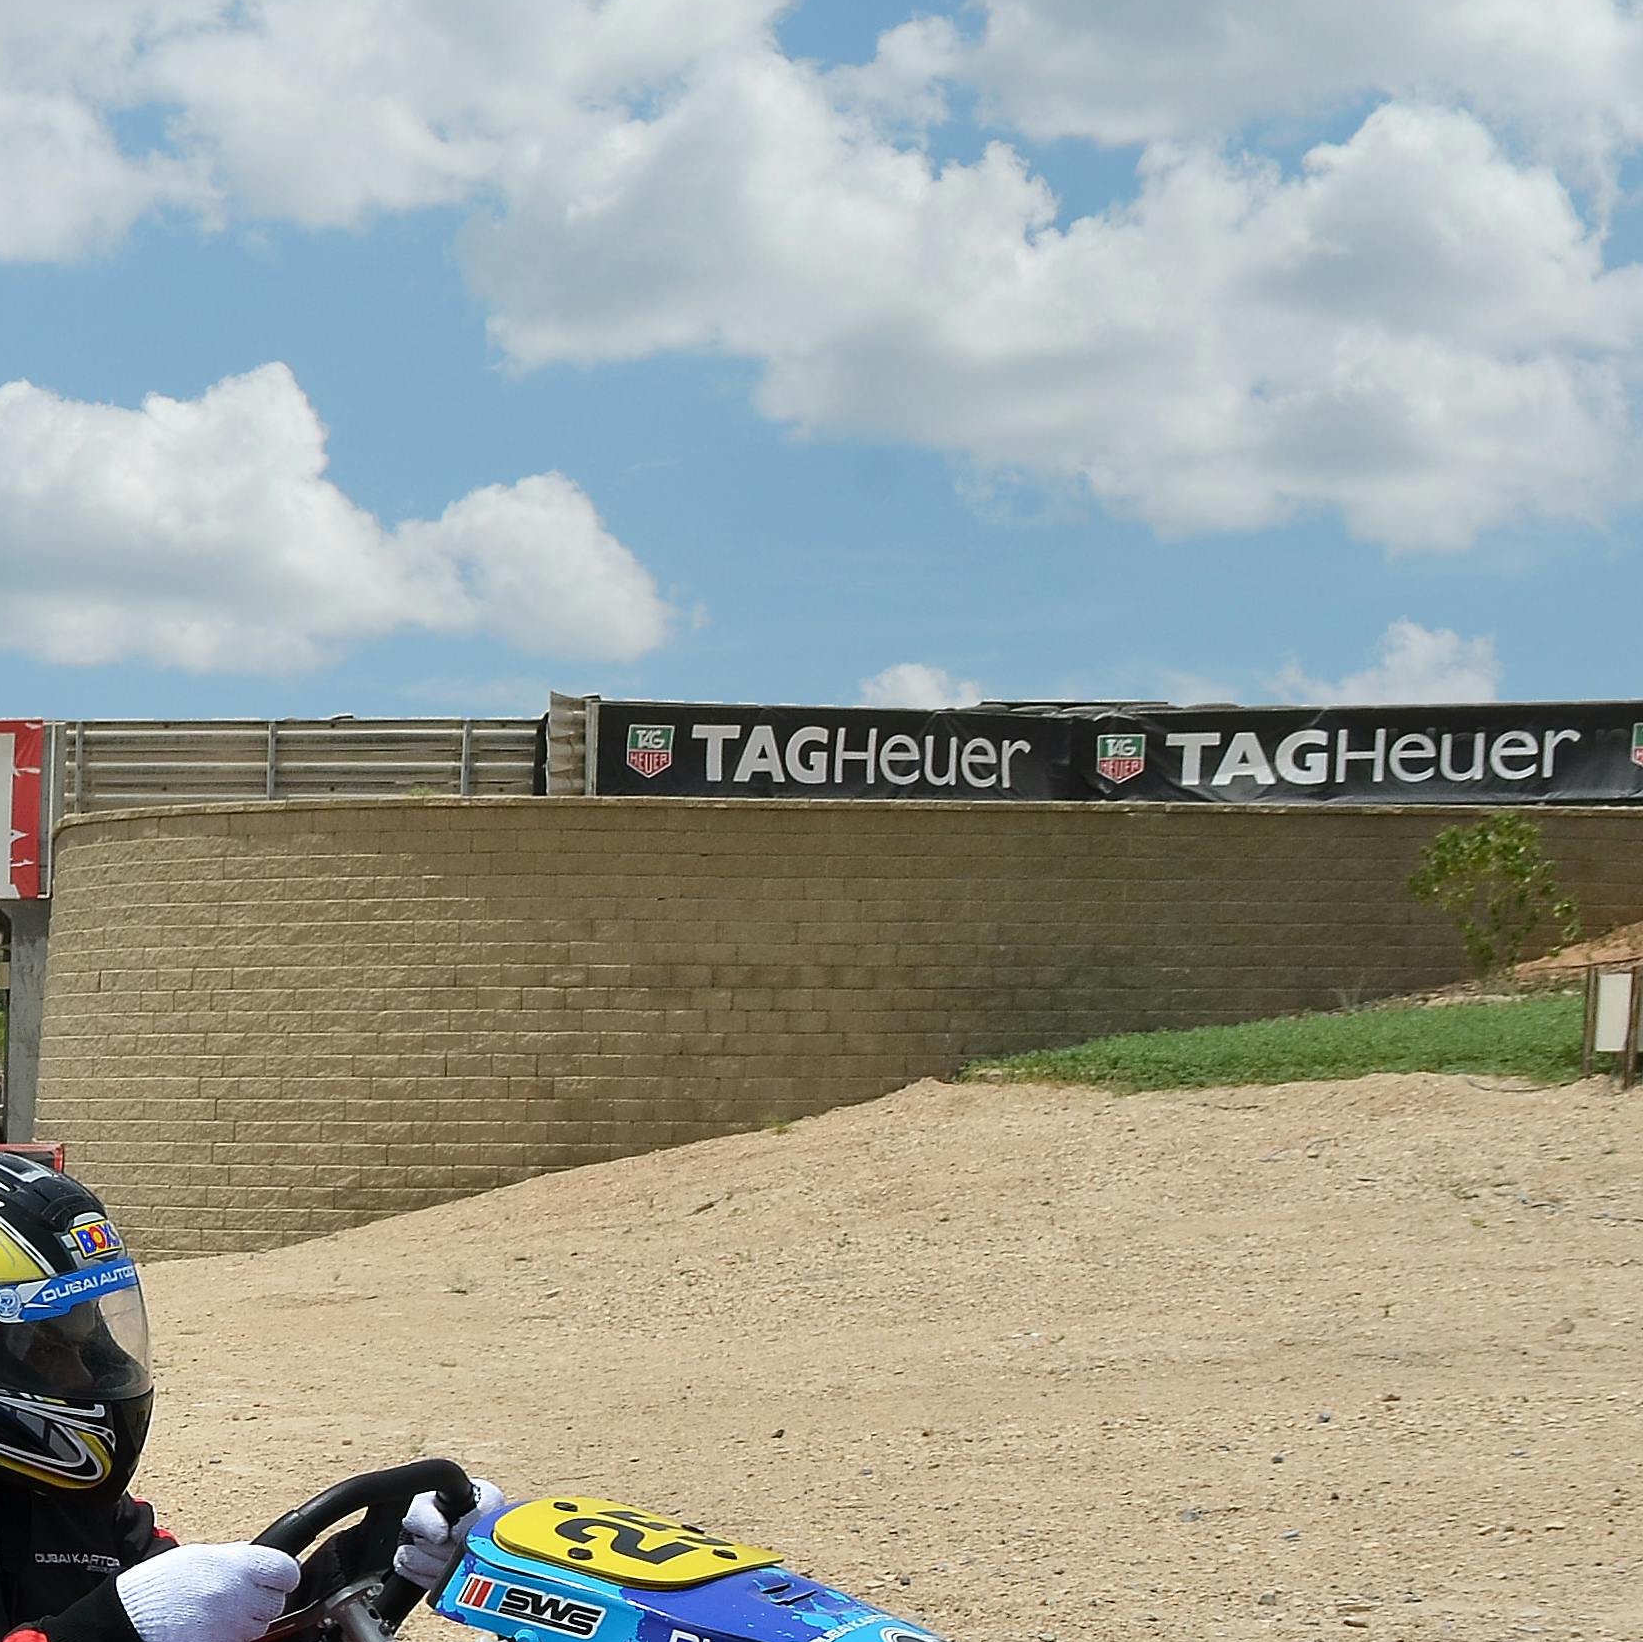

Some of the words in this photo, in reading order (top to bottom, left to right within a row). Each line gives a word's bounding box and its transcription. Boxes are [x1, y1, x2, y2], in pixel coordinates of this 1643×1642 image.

[635, 730, 666, 749] TAG
[629, 752, 668, 774] HEUER
[42, 1277, 99, 1302] DUBAI
[34, 1553, 71, 1563] DUBAI
[499, 1588, 602, 1635] SWS
